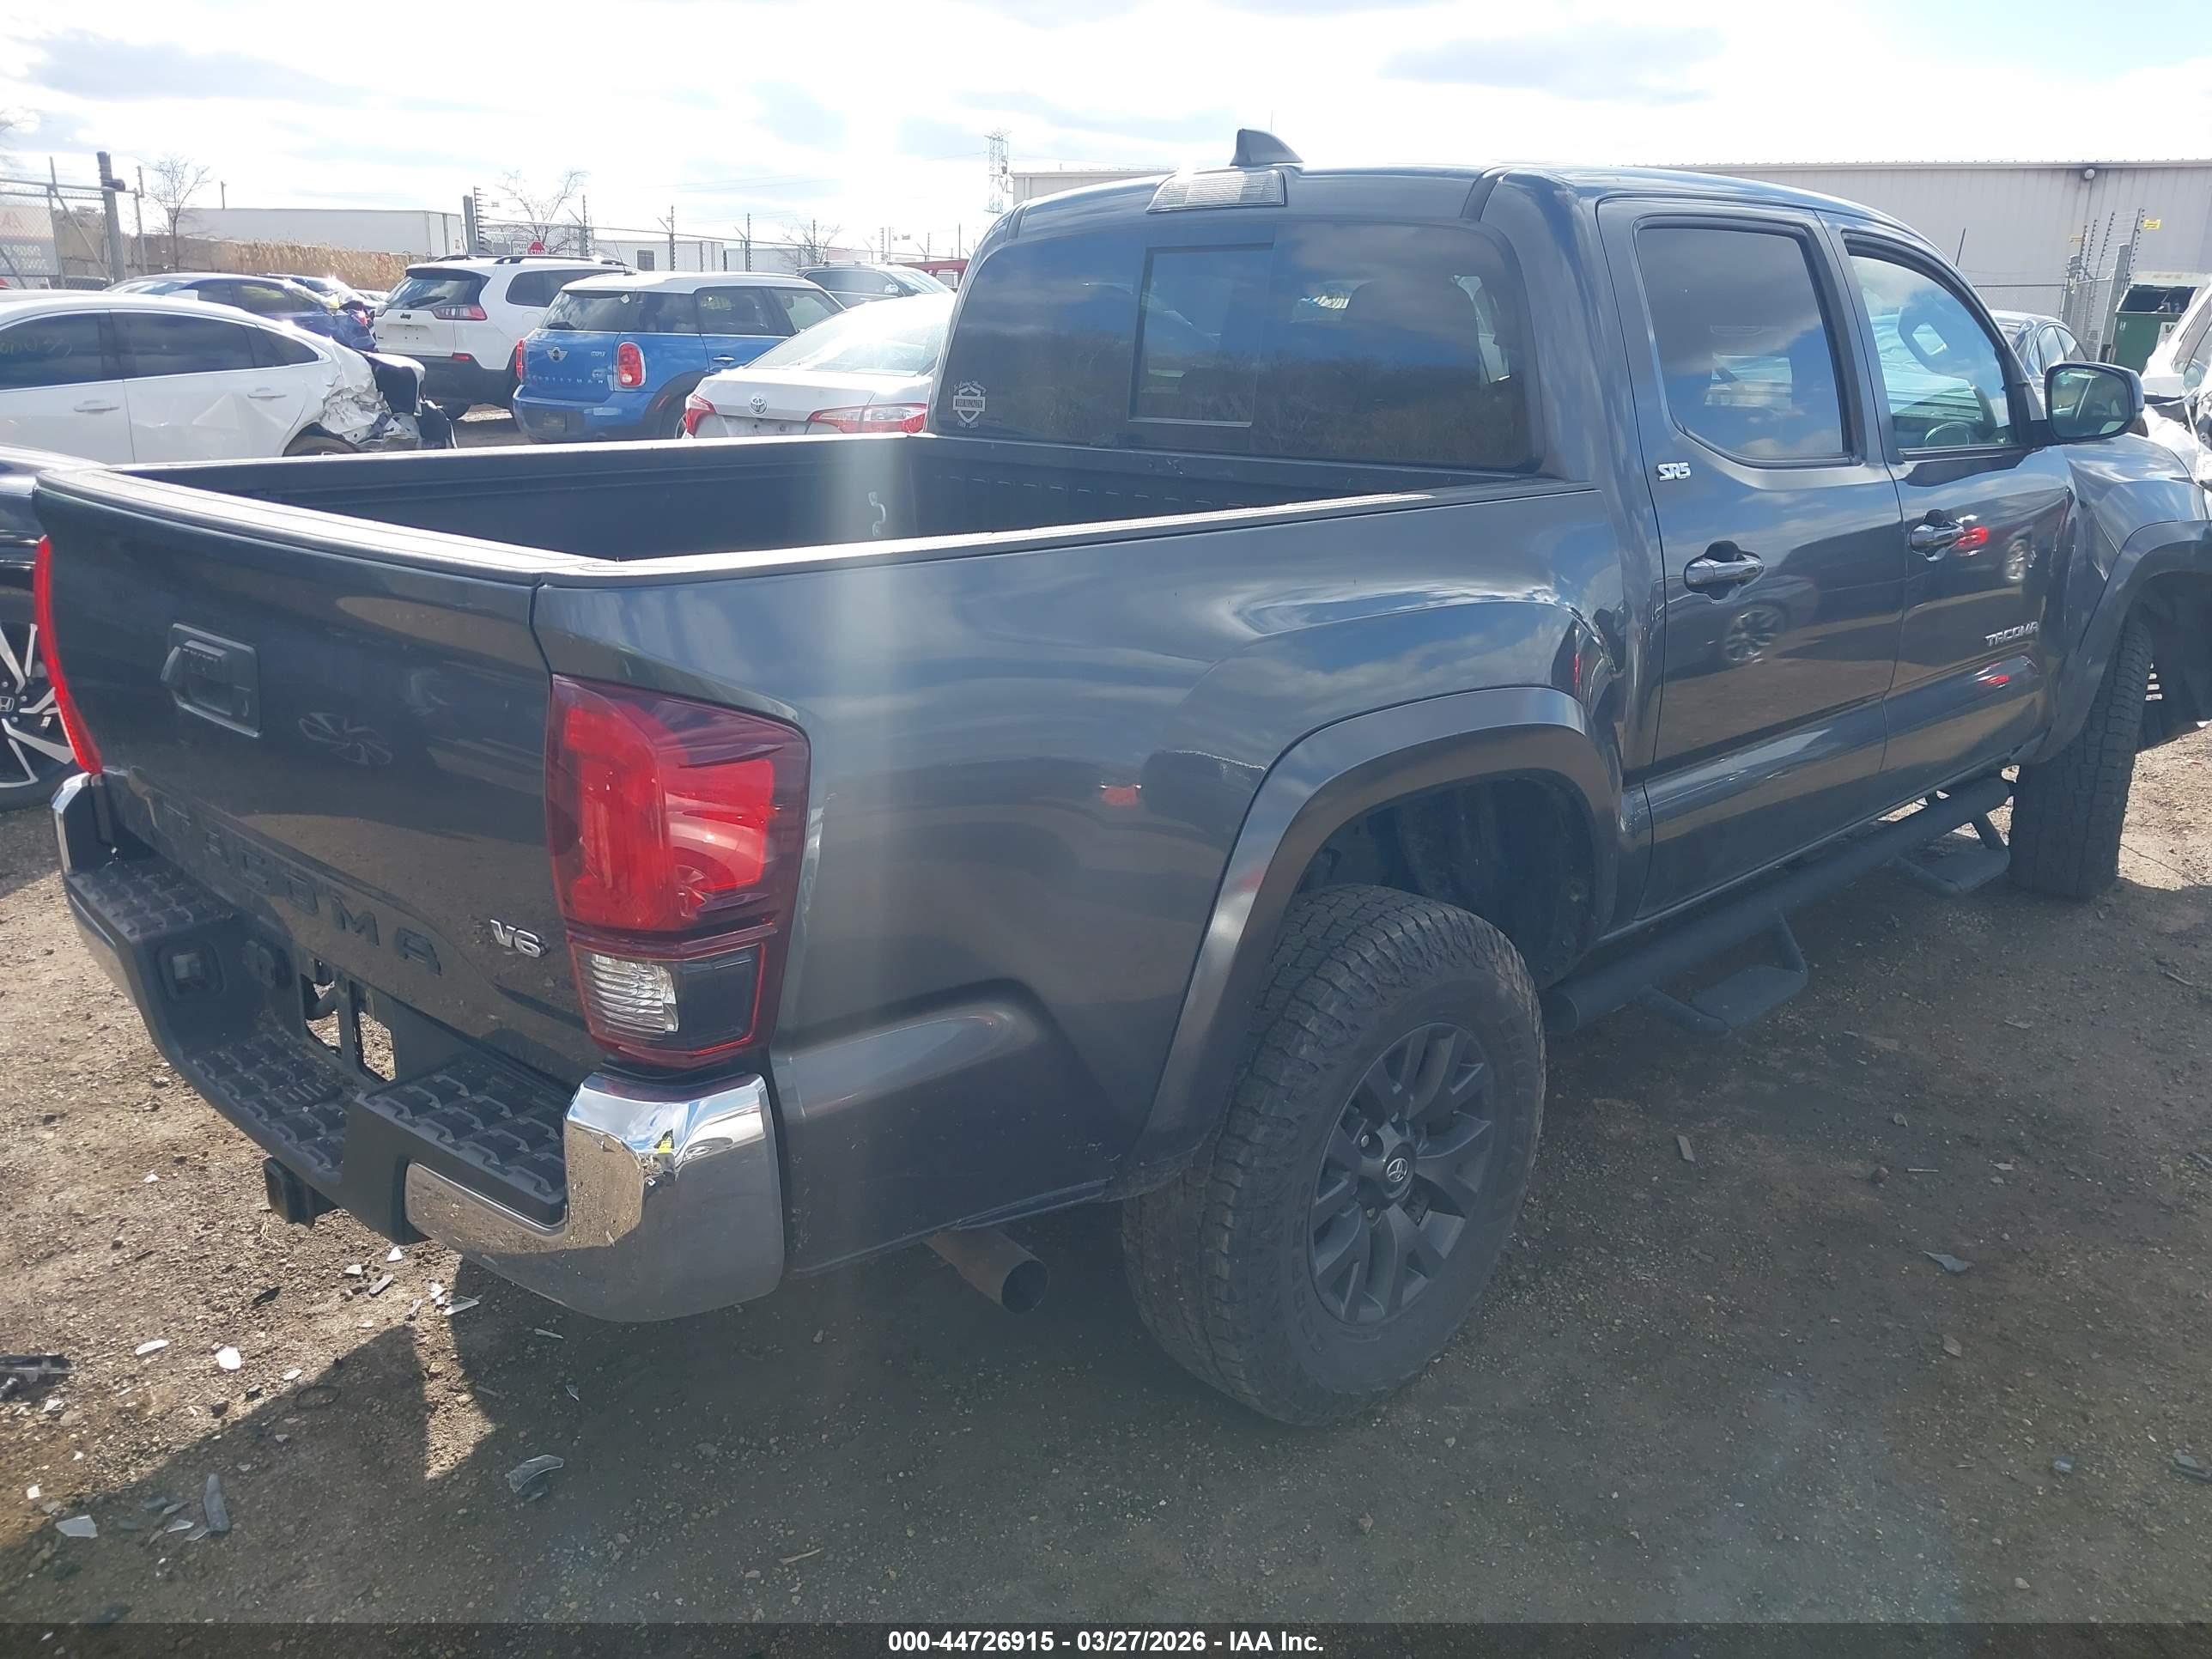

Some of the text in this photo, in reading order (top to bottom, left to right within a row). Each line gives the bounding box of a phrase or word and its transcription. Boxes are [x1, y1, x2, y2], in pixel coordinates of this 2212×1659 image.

[1657, 462, 1691, 481] SR5
[1984, 621, 2039, 647] TACOMA
[490, 918, 551, 958] V6
